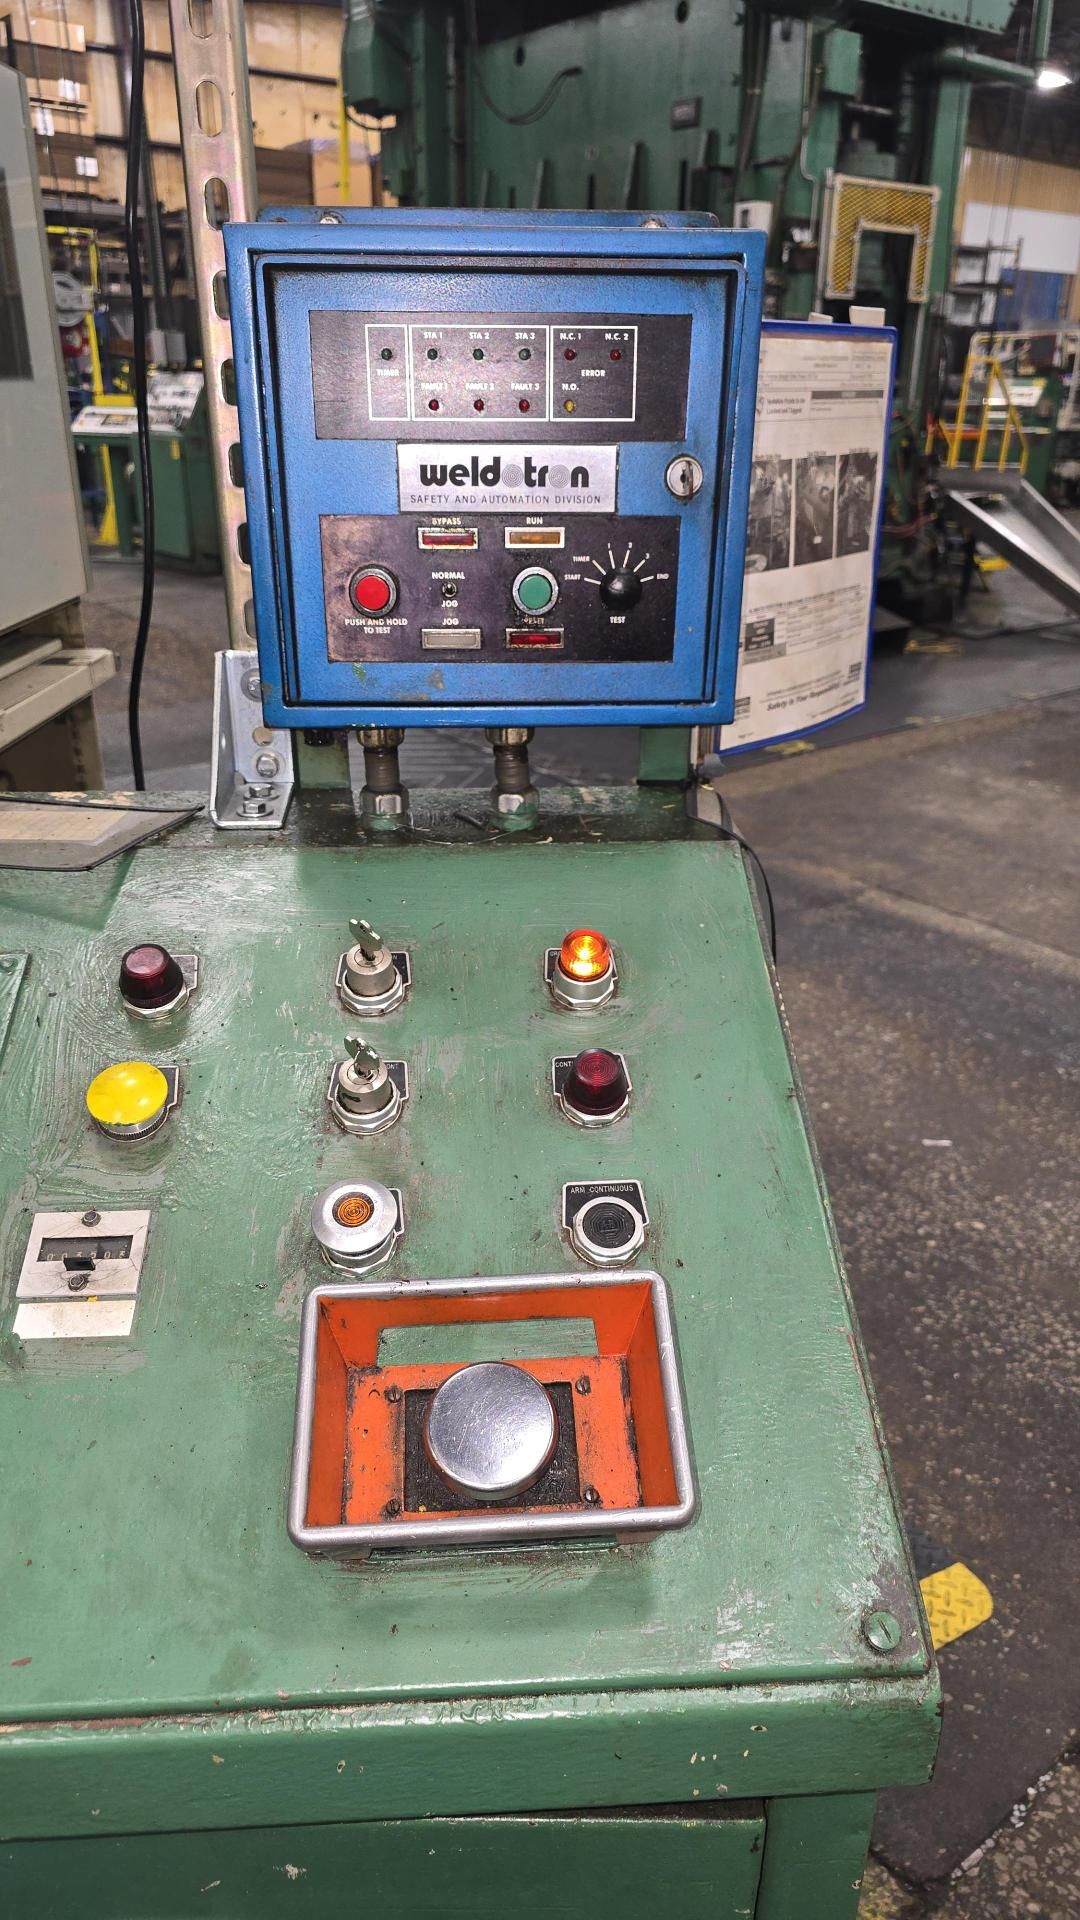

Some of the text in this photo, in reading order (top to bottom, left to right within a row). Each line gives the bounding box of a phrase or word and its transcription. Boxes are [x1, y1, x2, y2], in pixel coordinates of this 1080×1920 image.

[423, 331, 437, 340] STA
[469, 331, 490, 340] STA 2
[515, 332, 536, 340] STA 3
[559, 332, 577, 341] N.C.
[605, 333, 629, 341] N.C. 2
[376, 368, 400, 377] TIMER
[581, 369, 606, 377] ERROR
[465, 382, 488, 391] FAULT
[510, 383, 540, 391] FAULT 3
[562, 383, 579, 391] N.O.
[410, 494, 601, 504] SAFETY AND AUTOMATION DIVISION
[431, 517, 462, 526] BYPASS
[526, 517, 543, 525] RUN
[431, 571, 466, 580] NORMAL
[441, 600, 459, 608] JOG
[344, 618, 408, 626] PUSH AND HOLD
[442, 618, 460, 626] JOG
[609, 616, 626, 624] TEST
[363, 626, 391, 634] TO TEST
[589, 1184, 634, 1193] CONTINUOUS
